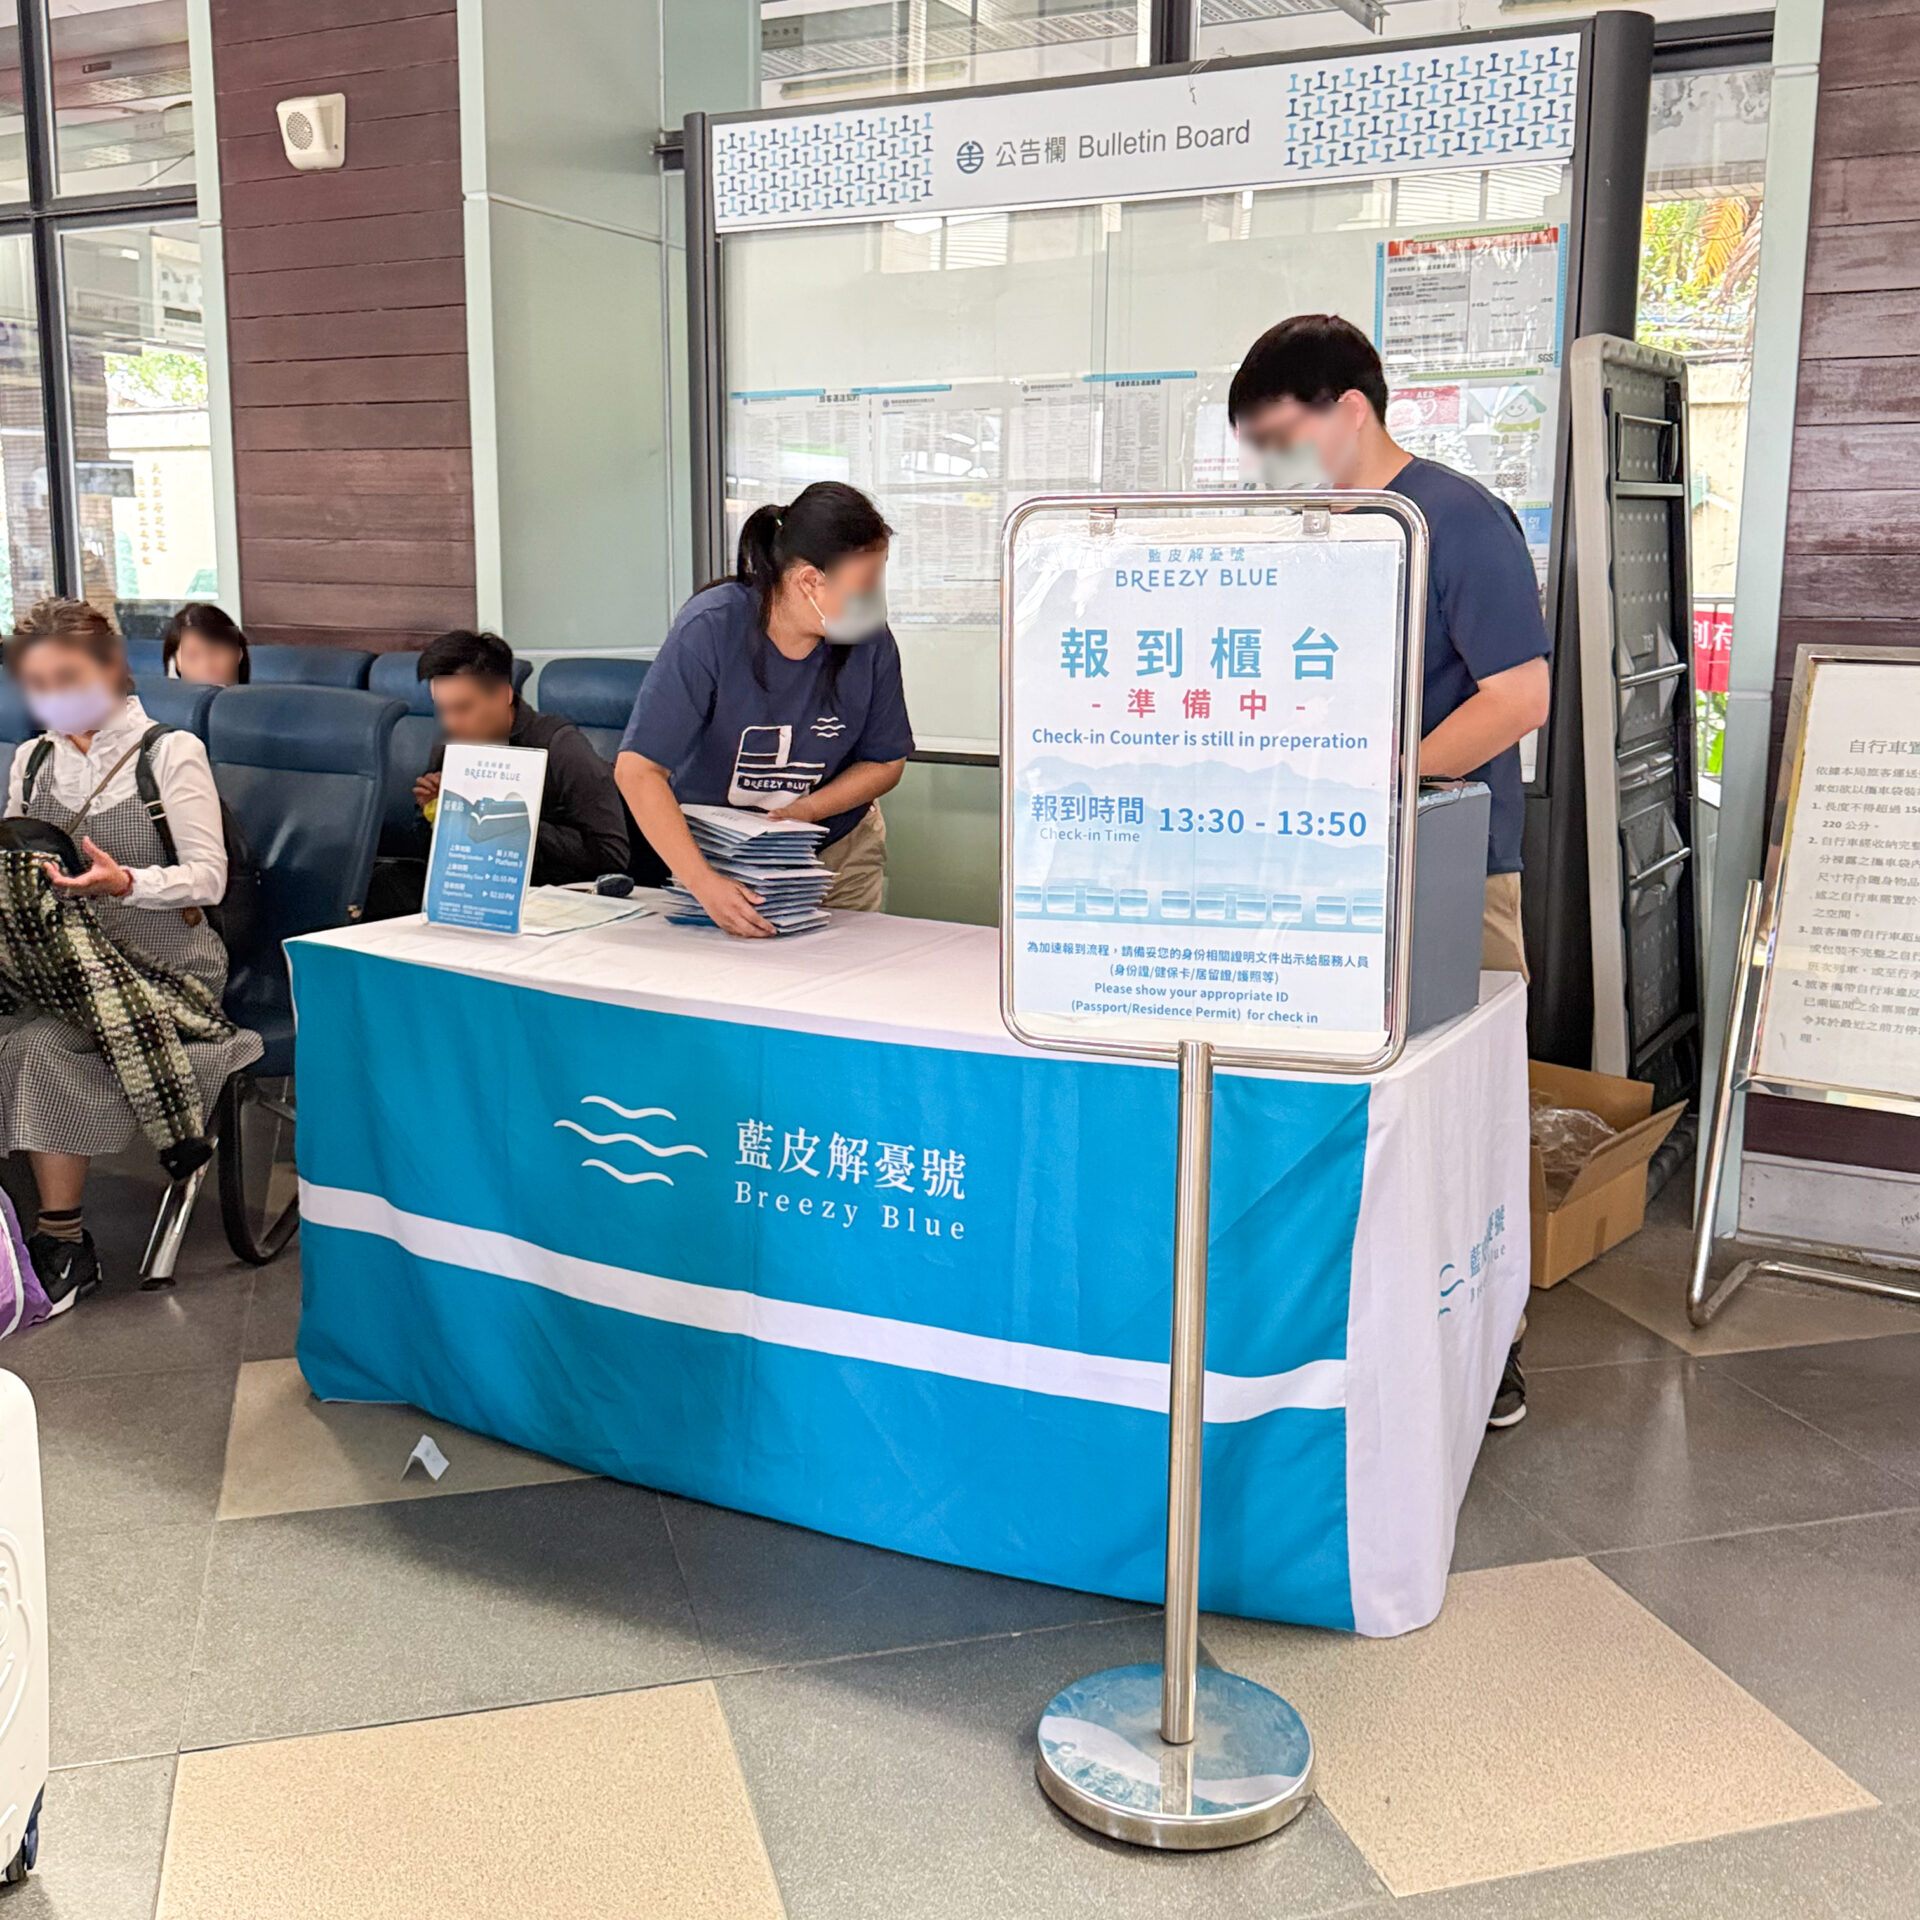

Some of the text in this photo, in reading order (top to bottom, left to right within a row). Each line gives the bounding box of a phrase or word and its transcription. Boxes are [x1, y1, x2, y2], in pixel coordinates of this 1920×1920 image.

[996, 119, 1250, 168] 公告欄 Bulletin Board
[1538, 353, 1554, 363] SGS
[1416, 391, 1435, 399] AED
[1115, 568, 1278, 593] BREEZY BLUE
[1061, 627, 1340, 680] 報到櫃台
[1032, 728, 1368, 751] Check-in Counter is still in preperation
[1816, 766, 1920, 779] 依據本局旅客運送
[743, 778, 810, 791] BREEZY BLUE
[1814, 783, 1920, 797] 車如欲以攜車袋裝
[1031, 794, 1144, 825] 報到時間
[1159, 808, 1244, 834] 13:30
[1277, 811, 1367, 837] 13:50
[1822, 820, 1842, 829] 220
[1040, 827, 1140, 842] Check-in Time
[1094, 982, 1289, 1003] Please show your appropriate ID
[1071, 1000, 1318, 1024] (Passport/Residence Permit) for check in
[1802, 1015, 1920, 1036] 令其於最近之前方停
[735, 1118, 967, 1200] 藍皮解憂號
[735, 1181, 966, 1240] Breezy Blue
